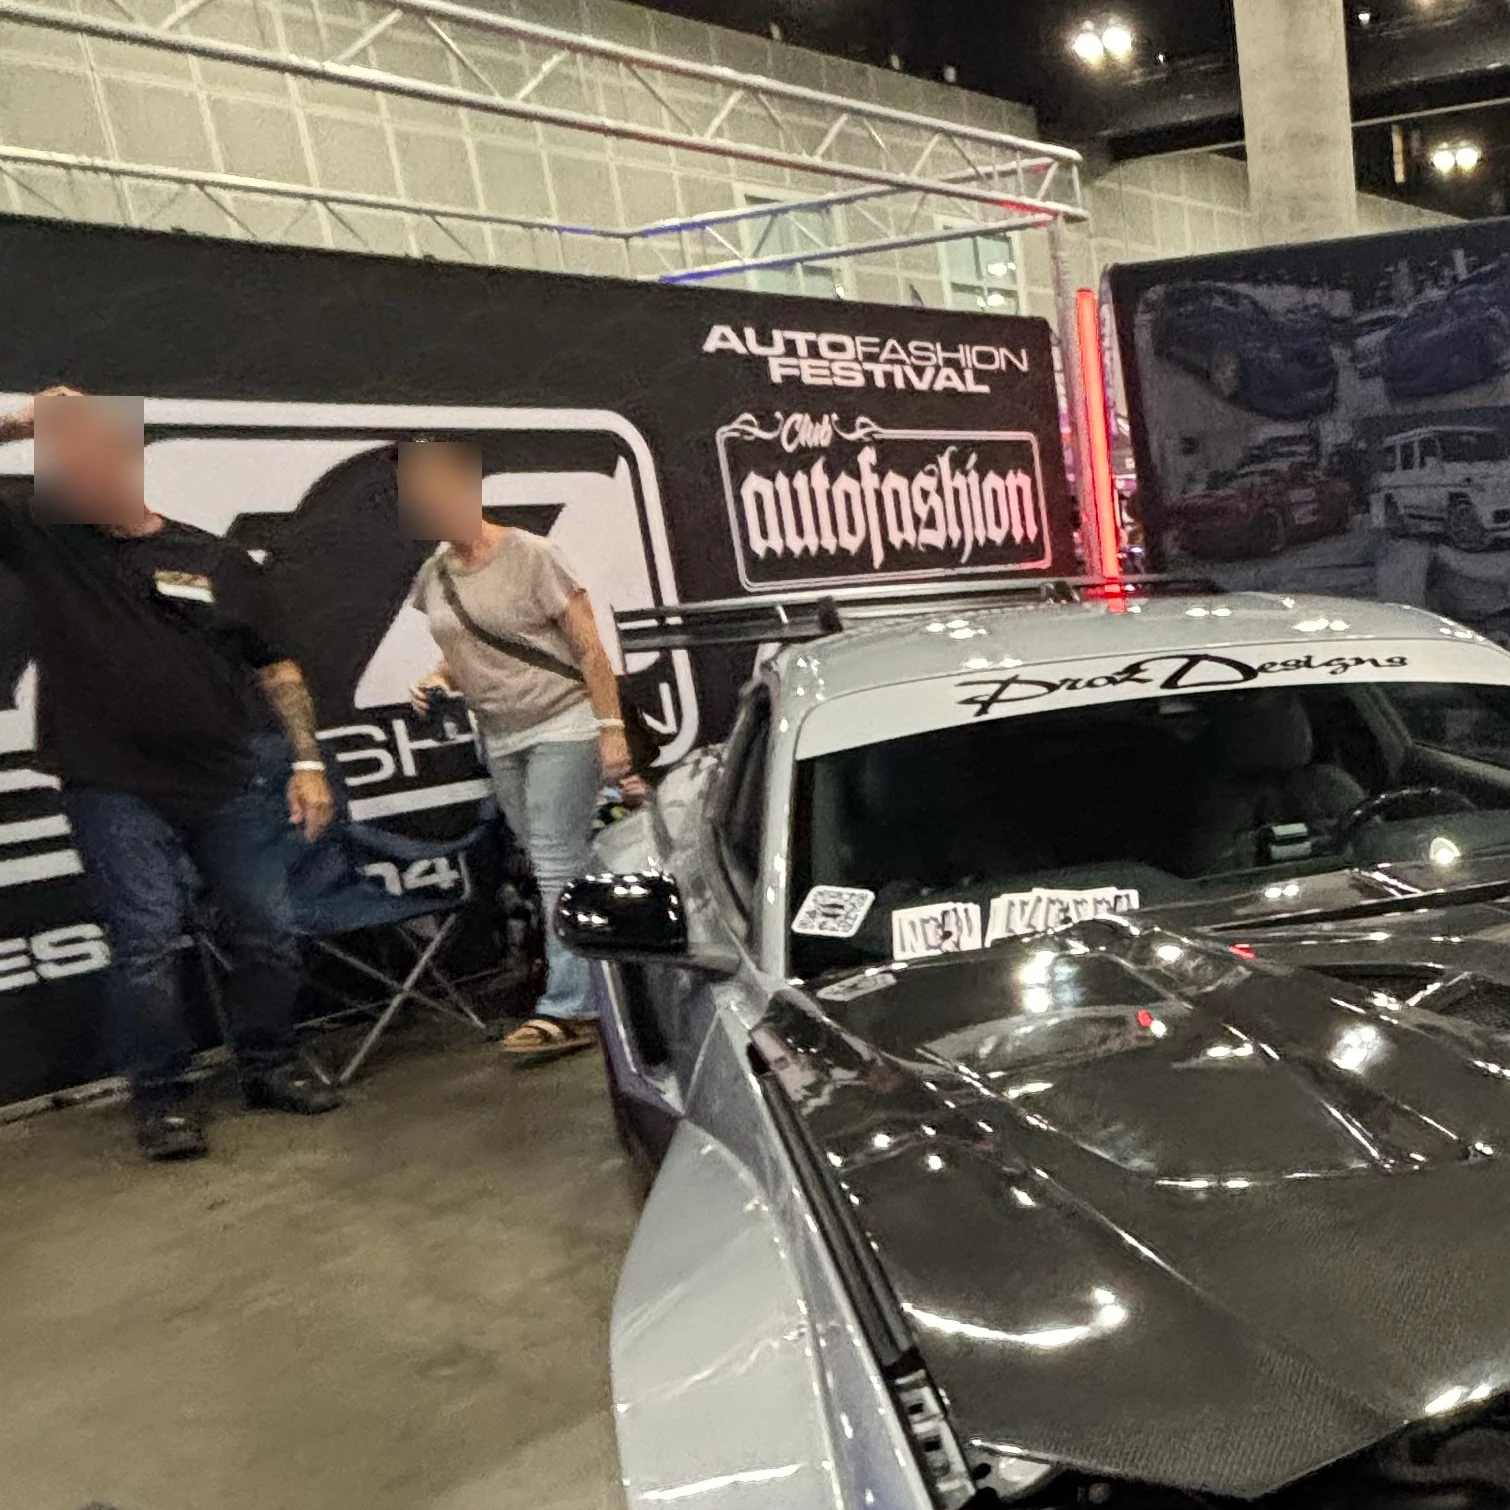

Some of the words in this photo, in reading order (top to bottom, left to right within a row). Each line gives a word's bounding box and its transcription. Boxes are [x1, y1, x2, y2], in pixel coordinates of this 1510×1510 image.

[702, 324, 1029, 372] AUTOFASHION
[767, 356, 990, 393] FESTIVAL
[781, 413, 833, 452] Club
[740, 446, 1038, 570] autofashion
